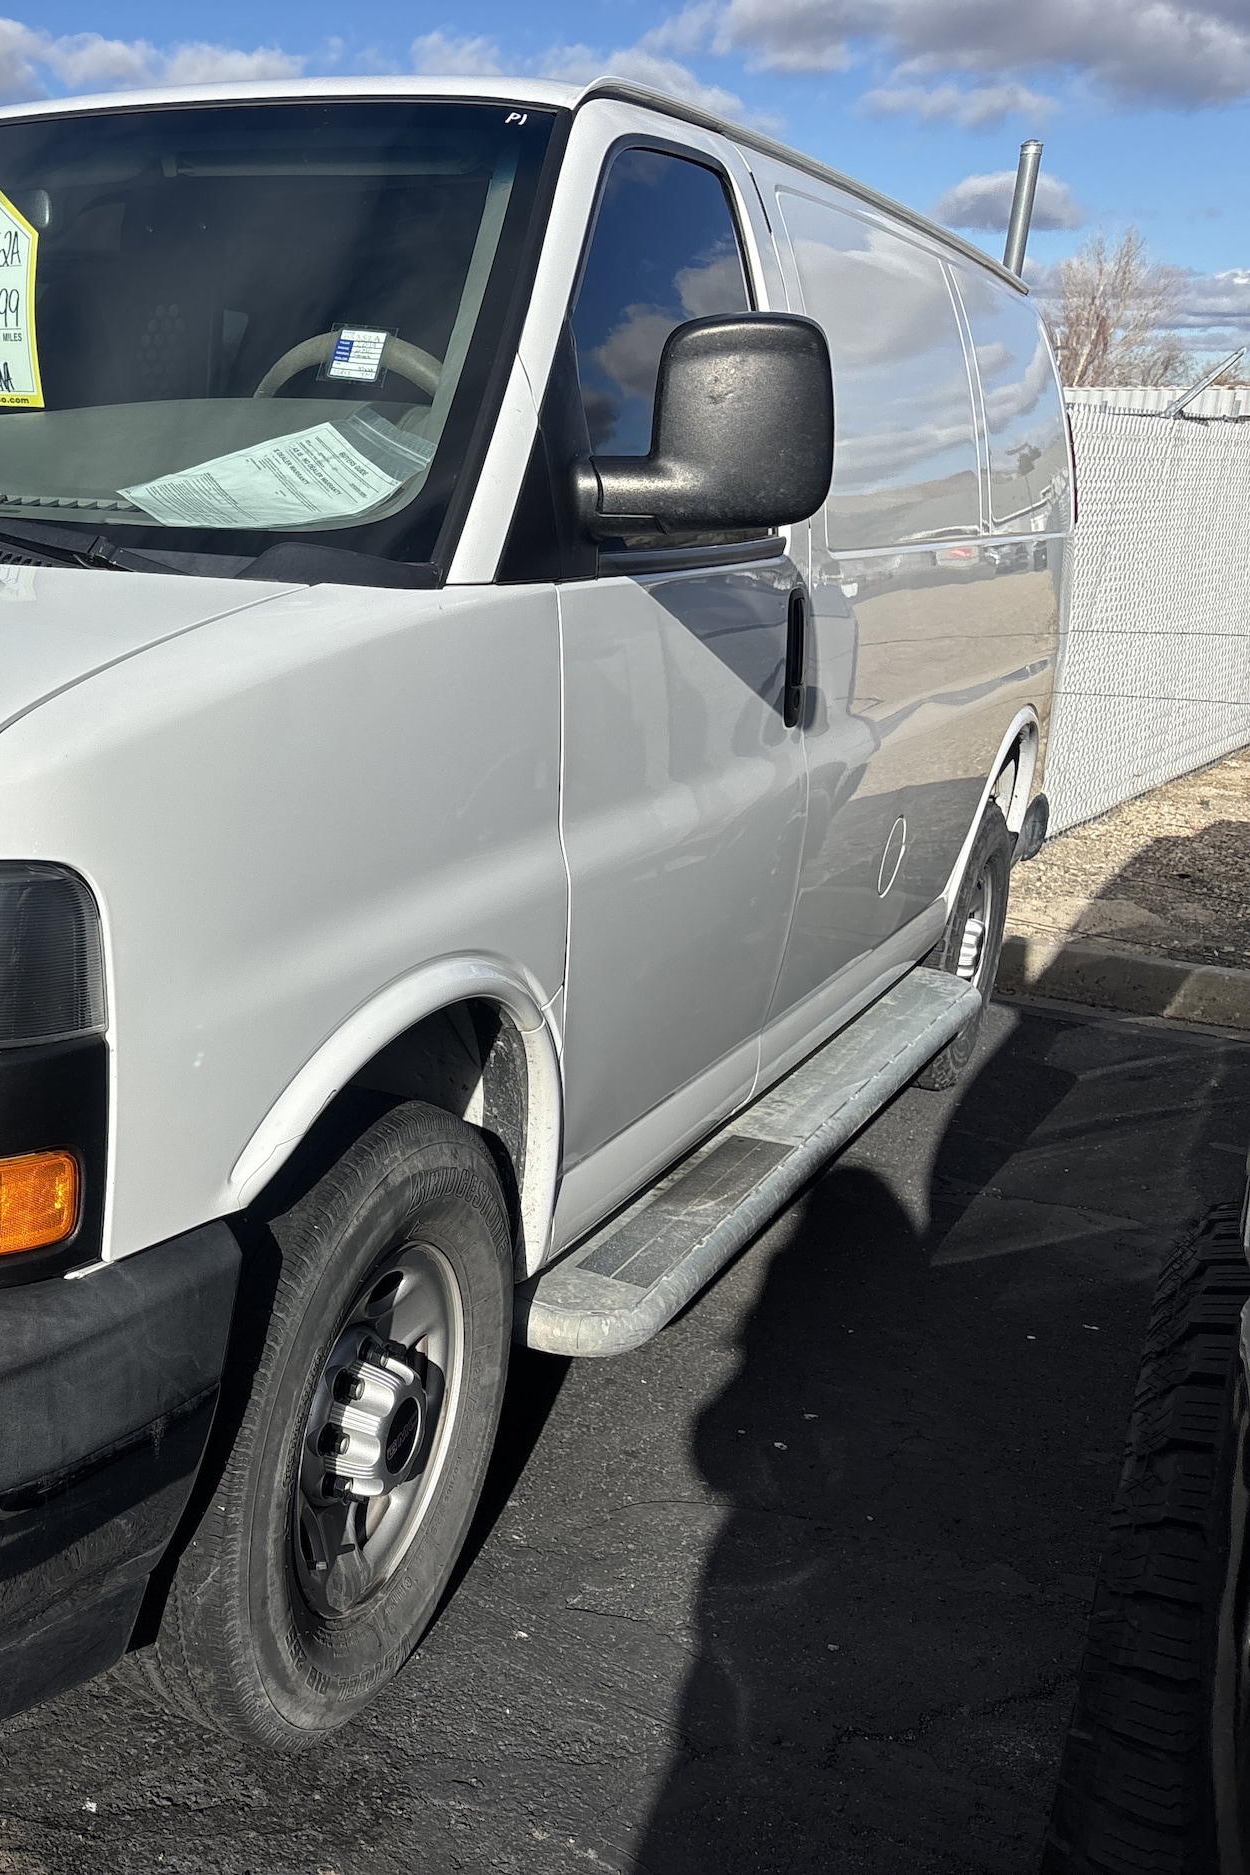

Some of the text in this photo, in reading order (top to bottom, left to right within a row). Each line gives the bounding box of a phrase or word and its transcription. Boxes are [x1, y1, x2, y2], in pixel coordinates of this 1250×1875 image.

[2, 333, 23, 342] MILES
[276, 451, 293, 467] DEALER
[289, 465, 310, 485] WARRANTY
[307, 463, 323, 478] DEALER
[320, 477, 342, 496] WARRANTY
[354, 465, 370, 477] GUIDE
[406, 1168, 510, 1258] BRIDGESTONE
[304, 1665, 331, 1695] RIB
